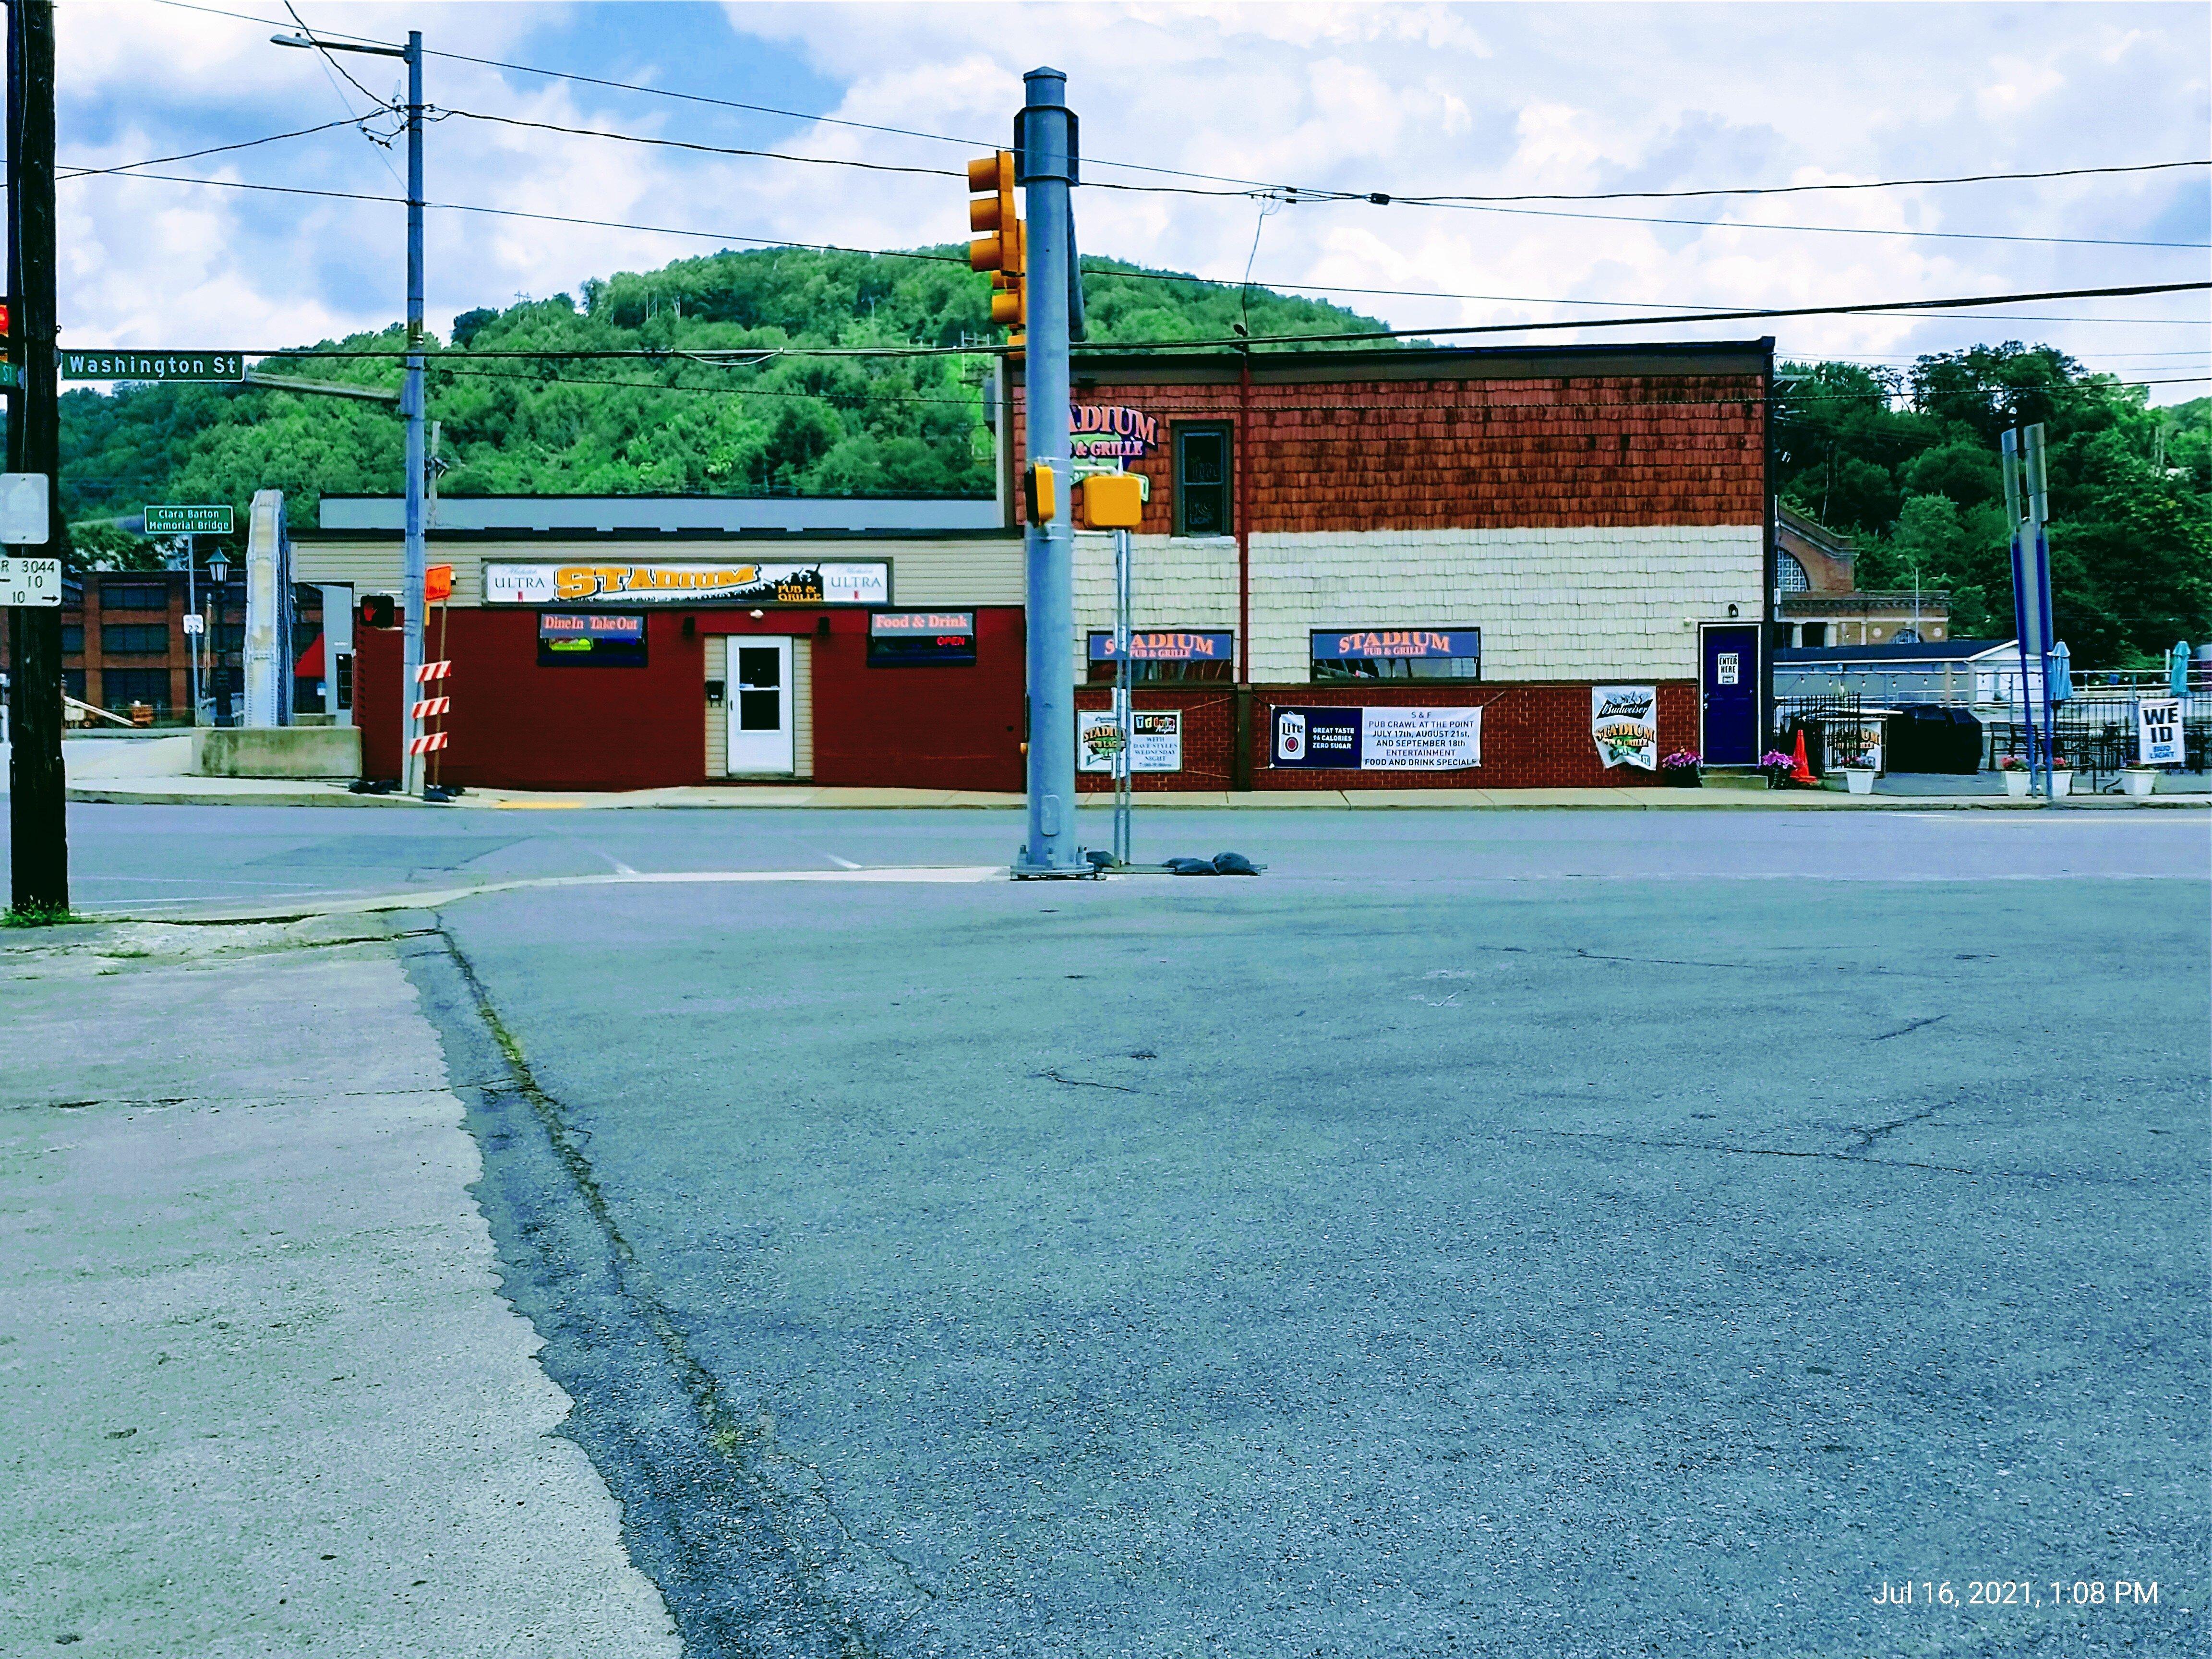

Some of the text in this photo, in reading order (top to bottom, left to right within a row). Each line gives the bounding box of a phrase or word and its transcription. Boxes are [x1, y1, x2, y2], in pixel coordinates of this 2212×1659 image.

[70, 355, 235, 378] Washington St
[1069, 406, 1156, 445] ADIUM
[1076, 441, 1143, 456] & GRILLE
[159, 510, 219, 519] Clara Barton
[150, 520, 228, 531] Memorial Bridge
[1, 560, 55, 574] R 3044
[27, 576, 43, 588] 10
[495, 577, 545, 588] ULTRA
[555, 565, 760, 599] STADIUM
[831, 577, 881, 588] ULTRA
[778, 585, 816, 593] PUB &
[12, 590, 25, 603] 10
[778, 593, 822, 601] GRILLE
[876, 615, 967, 628] Food & Drink
[937, 637, 965, 646] OPEN
[1105, 633, 1214, 656] SADIUM
[1339, 631, 1450, 653] STADIUM
[1364, 646, 1426, 655] PUB & GRILLE
[1602, 703, 1648, 714] Budweiser
[2143, 708, 2178, 725] WE
[1282, 722, 1303, 736] Lite
[1596, 723, 1655, 742] STADIUM
[2151, 726, 2173, 743] ID
